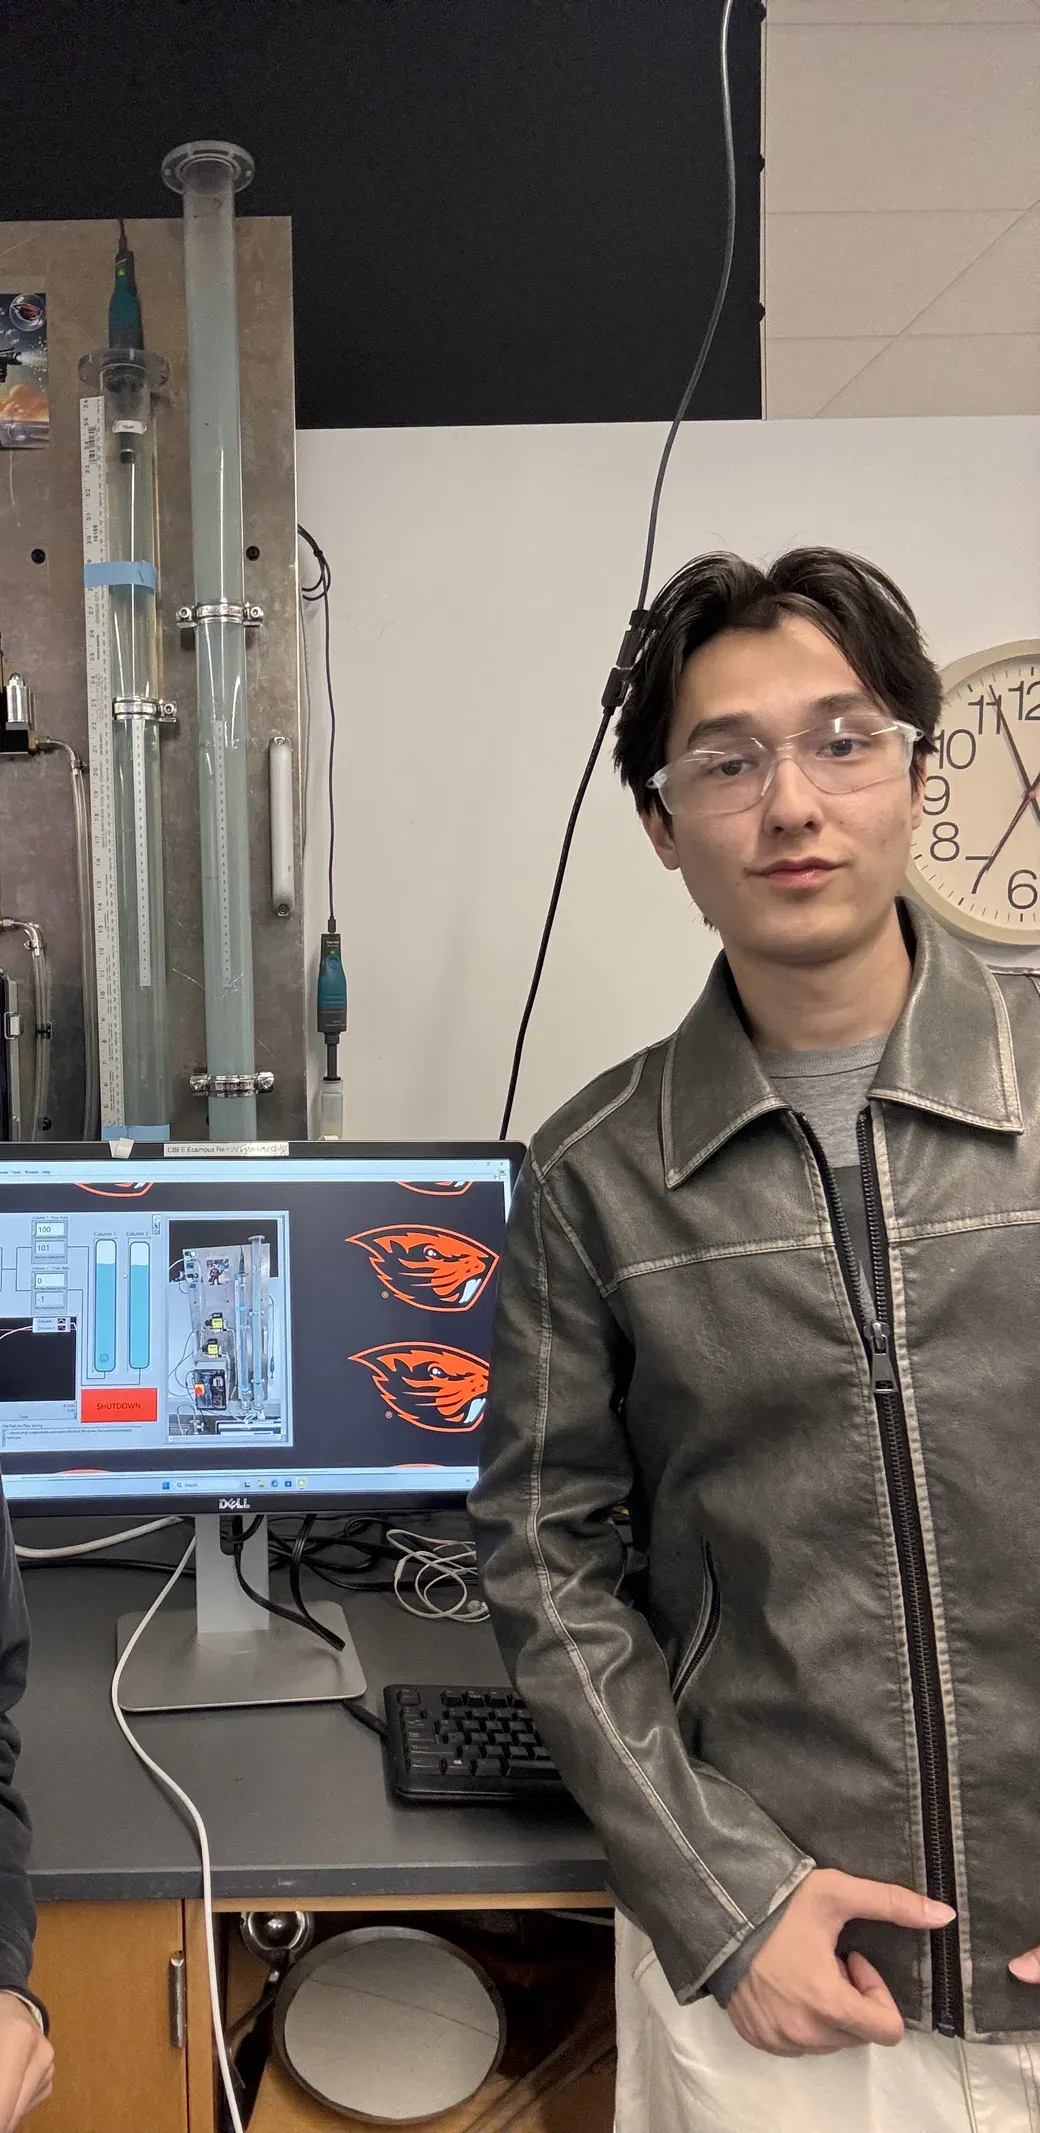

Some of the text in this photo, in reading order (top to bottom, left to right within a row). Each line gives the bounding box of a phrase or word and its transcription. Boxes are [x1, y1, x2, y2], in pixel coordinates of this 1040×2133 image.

[83, 399, 89, 408] 36
[83, 417, 89, 426] 35
[85, 465, 90, 474] 33
[85, 488, 91, 497] 32
[86, 512, 91, 521] 31
[87, 535, 92, 545] 30
[88, 606, 94, 615] 27
[89, 629, 94, 638] 26
[90, 652, 95, 661] 25
[90, 675, 96, 684] 24
[91, 698, 96, 708] 23
[968, 694, 1002, 735] 11
[91, 721, 97, 730] 22
[92, 744, 98, 754] 21
[935, 728, 976, 770] 10
[93, 767, 98, 776] 20
[93, 790, 99, 799] 19
[922, 775, 950, 815] 9
[94, 812, 99, 821] 18
[95, 835, 100, 844] 17
[929, 821, 960, 862] 8
[95, 857, 101, 867] 16
[965, 855, 994, 894] 7
[96, 880, 102, 889] 15
[1007, 869, 1038, 910] 6
[97, 902, 102, 911] 14
[98, 925, 103, 933] 13
[98, 947, 104, 955] 12
[100, 990, 105, 999] 10
[187, 1146, 215, 1155] Ecampus
[96, 1402, 141, 1410] SHUTDOWN
[218, 1498, 251, 1510] DELL
